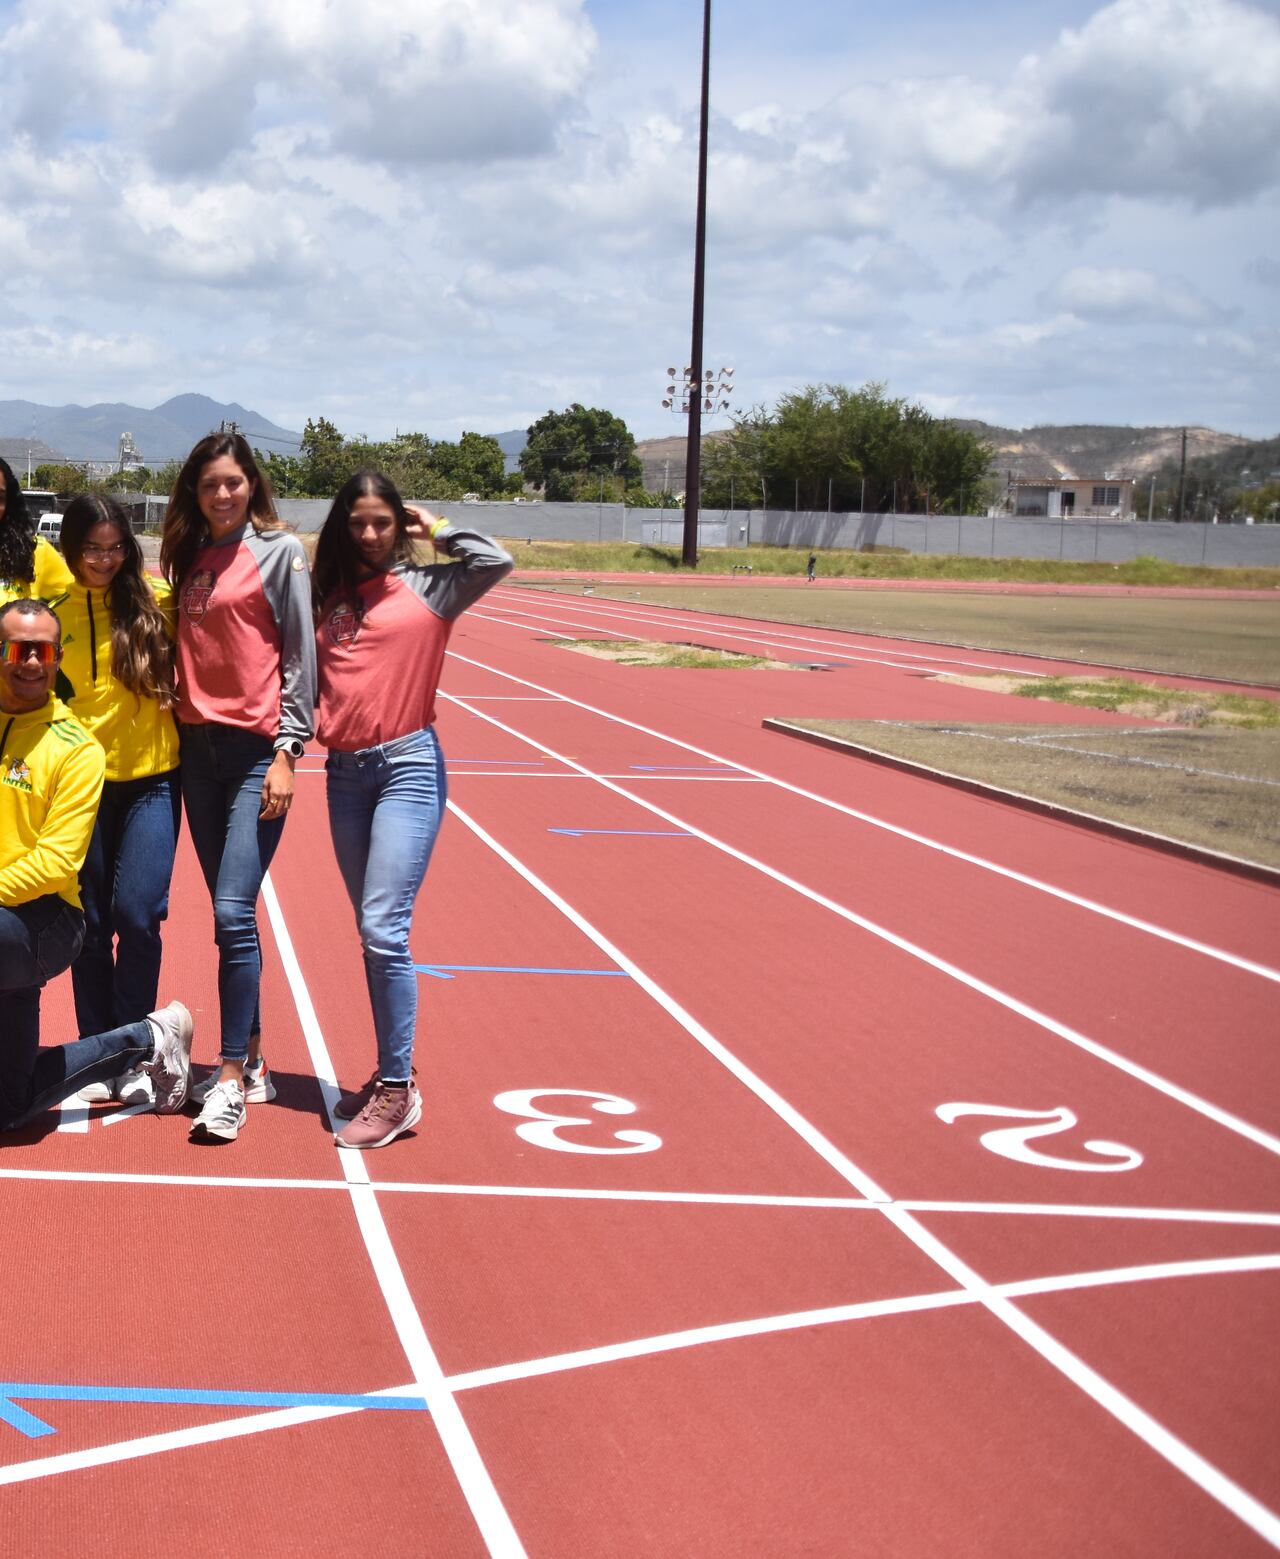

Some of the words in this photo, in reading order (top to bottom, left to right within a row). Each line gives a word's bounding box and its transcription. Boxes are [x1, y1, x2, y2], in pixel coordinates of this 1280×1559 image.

[2, 776, 33, 792] INTER
[493, 1089, 662, 1155] 3
[935, 1102, 1143, 1173] 2
